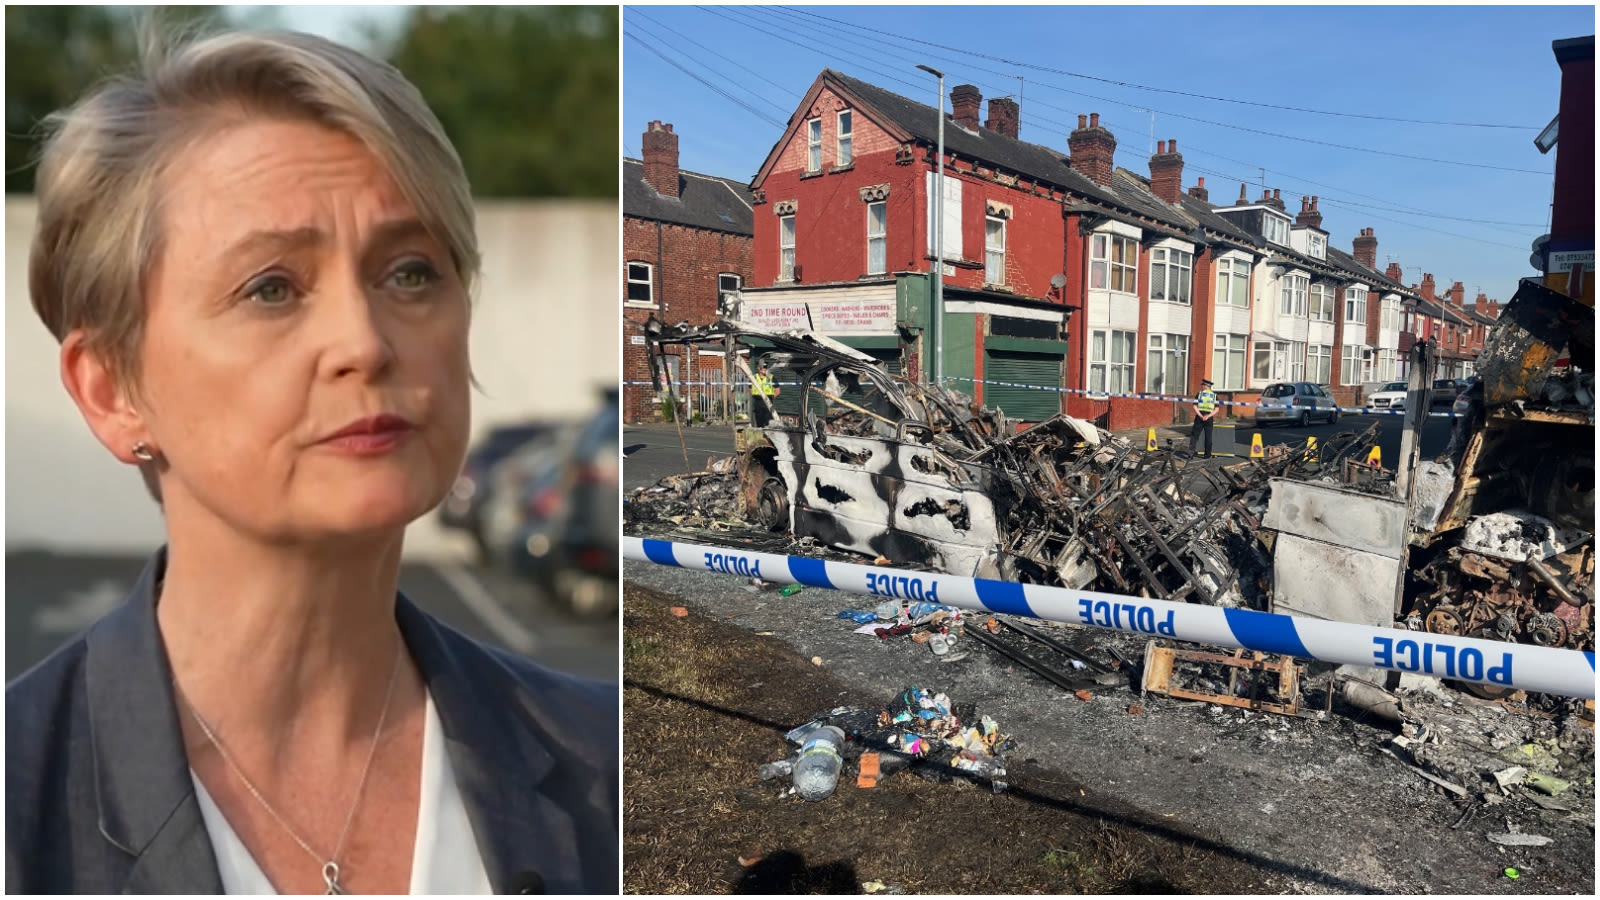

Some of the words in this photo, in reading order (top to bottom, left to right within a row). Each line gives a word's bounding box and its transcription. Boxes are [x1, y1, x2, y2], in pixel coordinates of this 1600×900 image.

[751, 308, 763, 318] 2ND
[765, 307, 780, 317] TIME
[782, 307, 806, 317] ROUND
[704, 552, 763, 579] POLICE
[866, 572, 941, 603] POLICE
[1078, 598, 1177, 637] POLICE
[1373, 636, 1513, 686] POLICE
